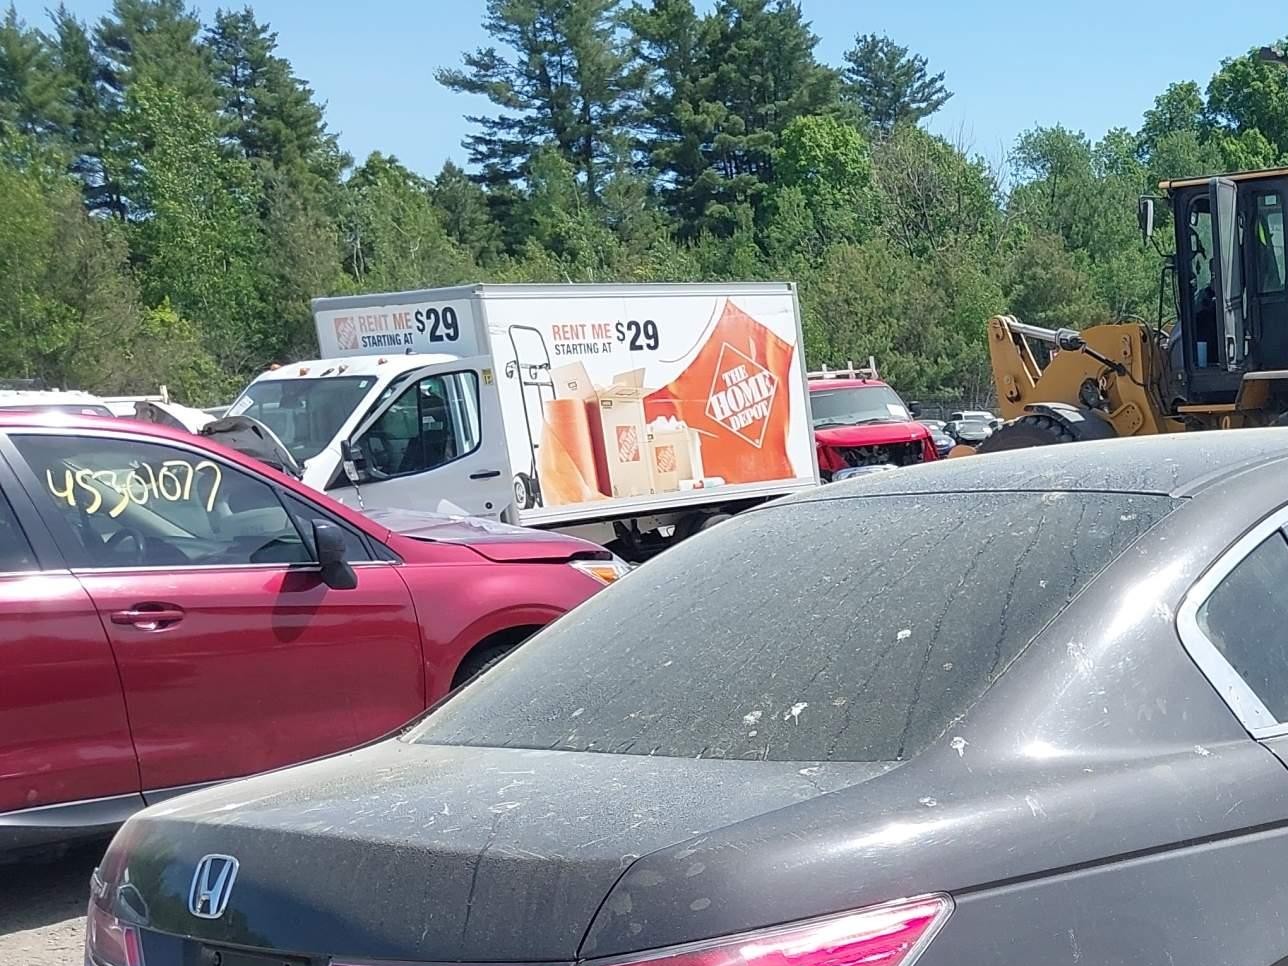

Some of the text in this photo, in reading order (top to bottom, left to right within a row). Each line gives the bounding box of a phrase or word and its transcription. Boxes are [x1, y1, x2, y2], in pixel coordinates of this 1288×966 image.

[358, 314, 389, 333] RENT
[392, 312, 413, 330] ME
[415, 306, 460, 343] $29
[552, 323, 613, 341] RENT ME
[361, 333, 414, 348] STARTING AT
[615, 319, 660, 352] $29
[554, 342, 613, 356] STARTING AT
[722, 364, 749, 388] THE
[711, 371, 775, 421] HOME
[729, 400, 769, 432] DEPOT
